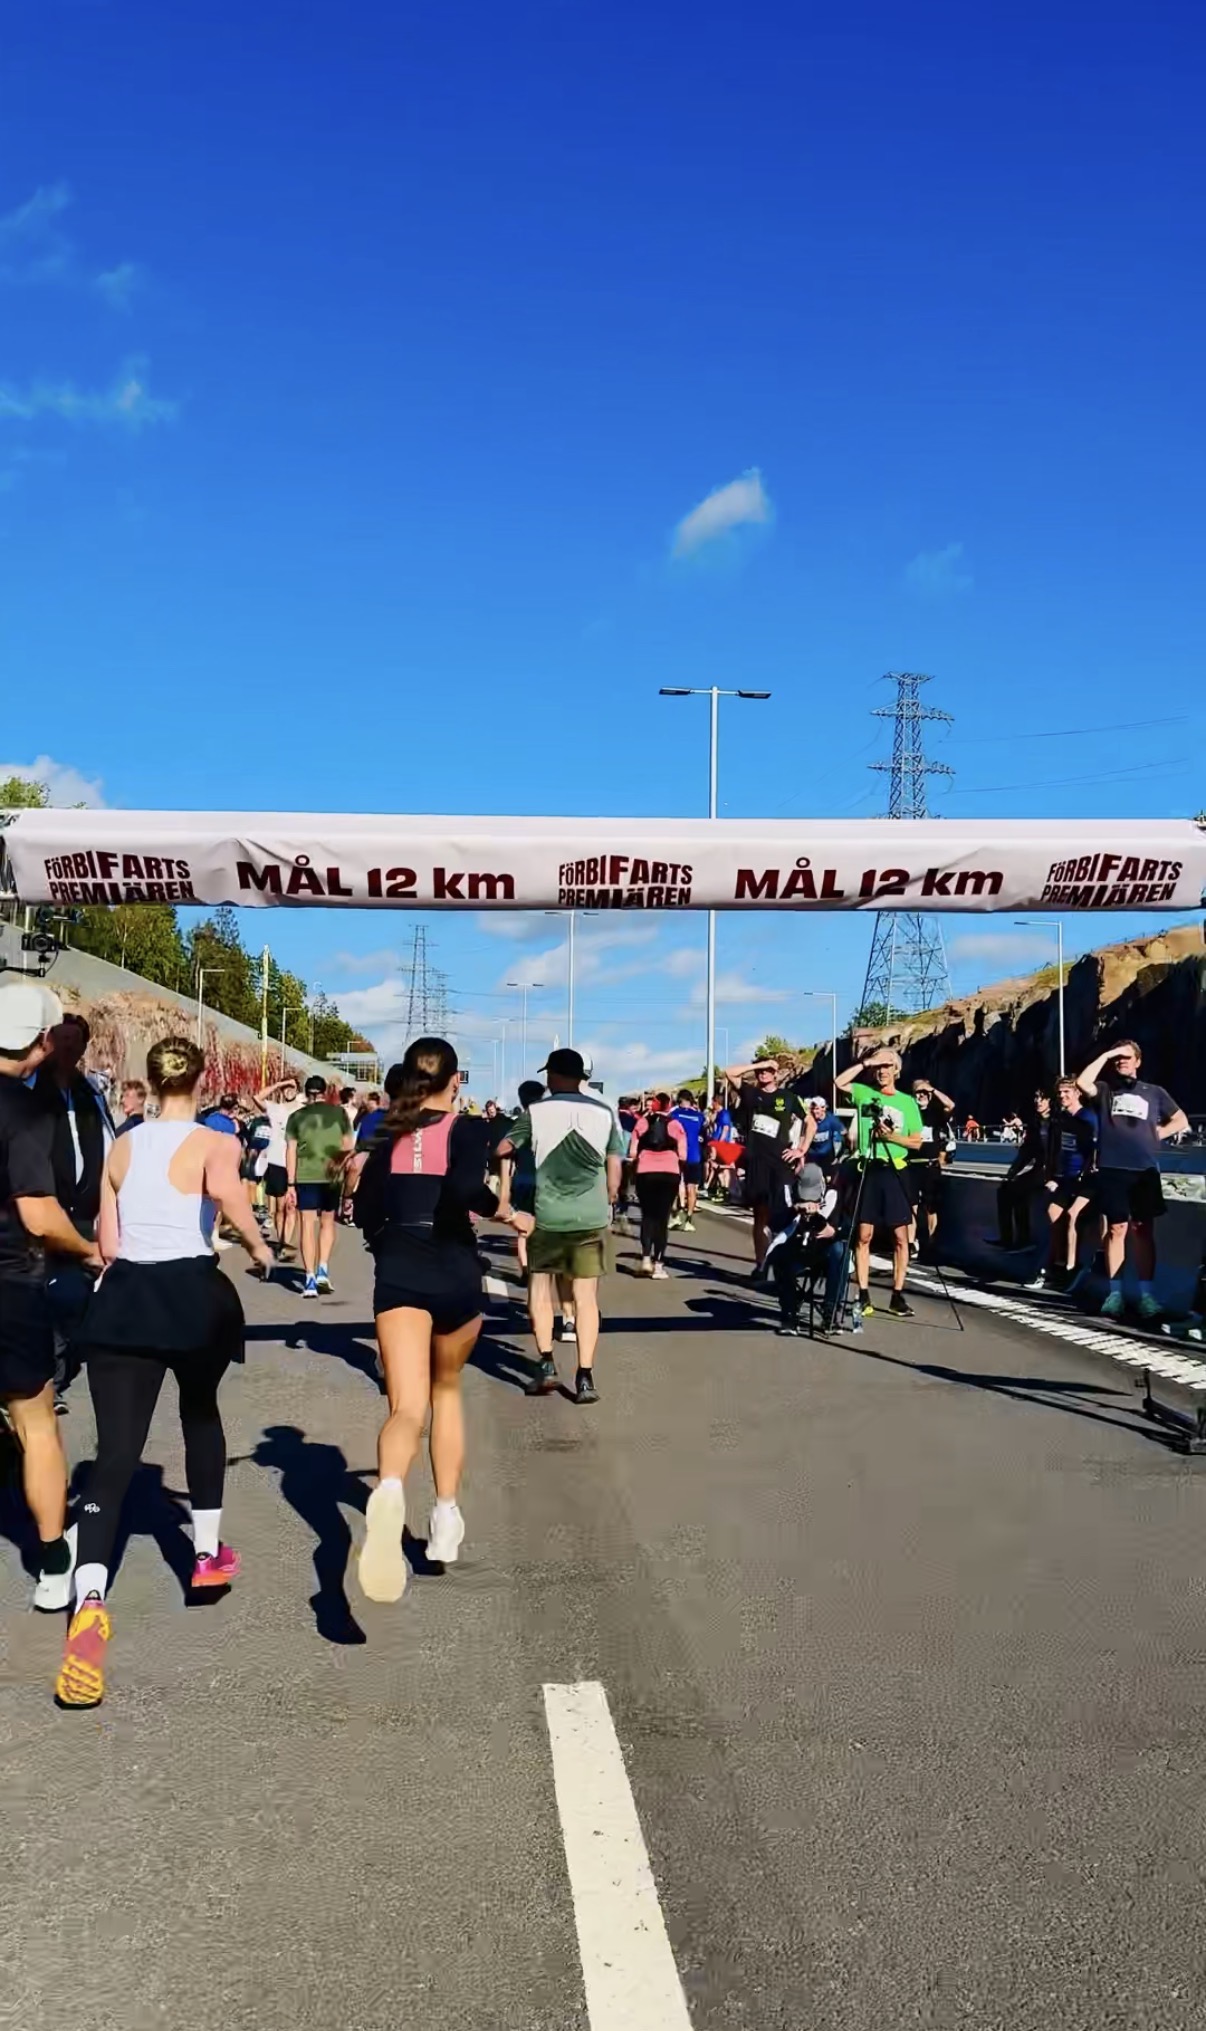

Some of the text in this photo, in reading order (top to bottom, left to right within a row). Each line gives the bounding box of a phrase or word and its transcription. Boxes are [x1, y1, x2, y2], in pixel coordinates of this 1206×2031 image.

[44, 851, 191, 880] FÖRBIFARTS
[236, 854, 516, 900] MÅL 12 km
[558, 854, 693, 886] FÖRBIFARTS
[734, 856, 1004, 900] MÅL 12 km
[1046, 853, 1183, 883] FÖRBIFARTS
[48, 881, 195, 905] PREMIÄREN
[558, 886, 692, 909] PREMIÄREN
[1040, 882, 1177, 908] PREMIÄREN
